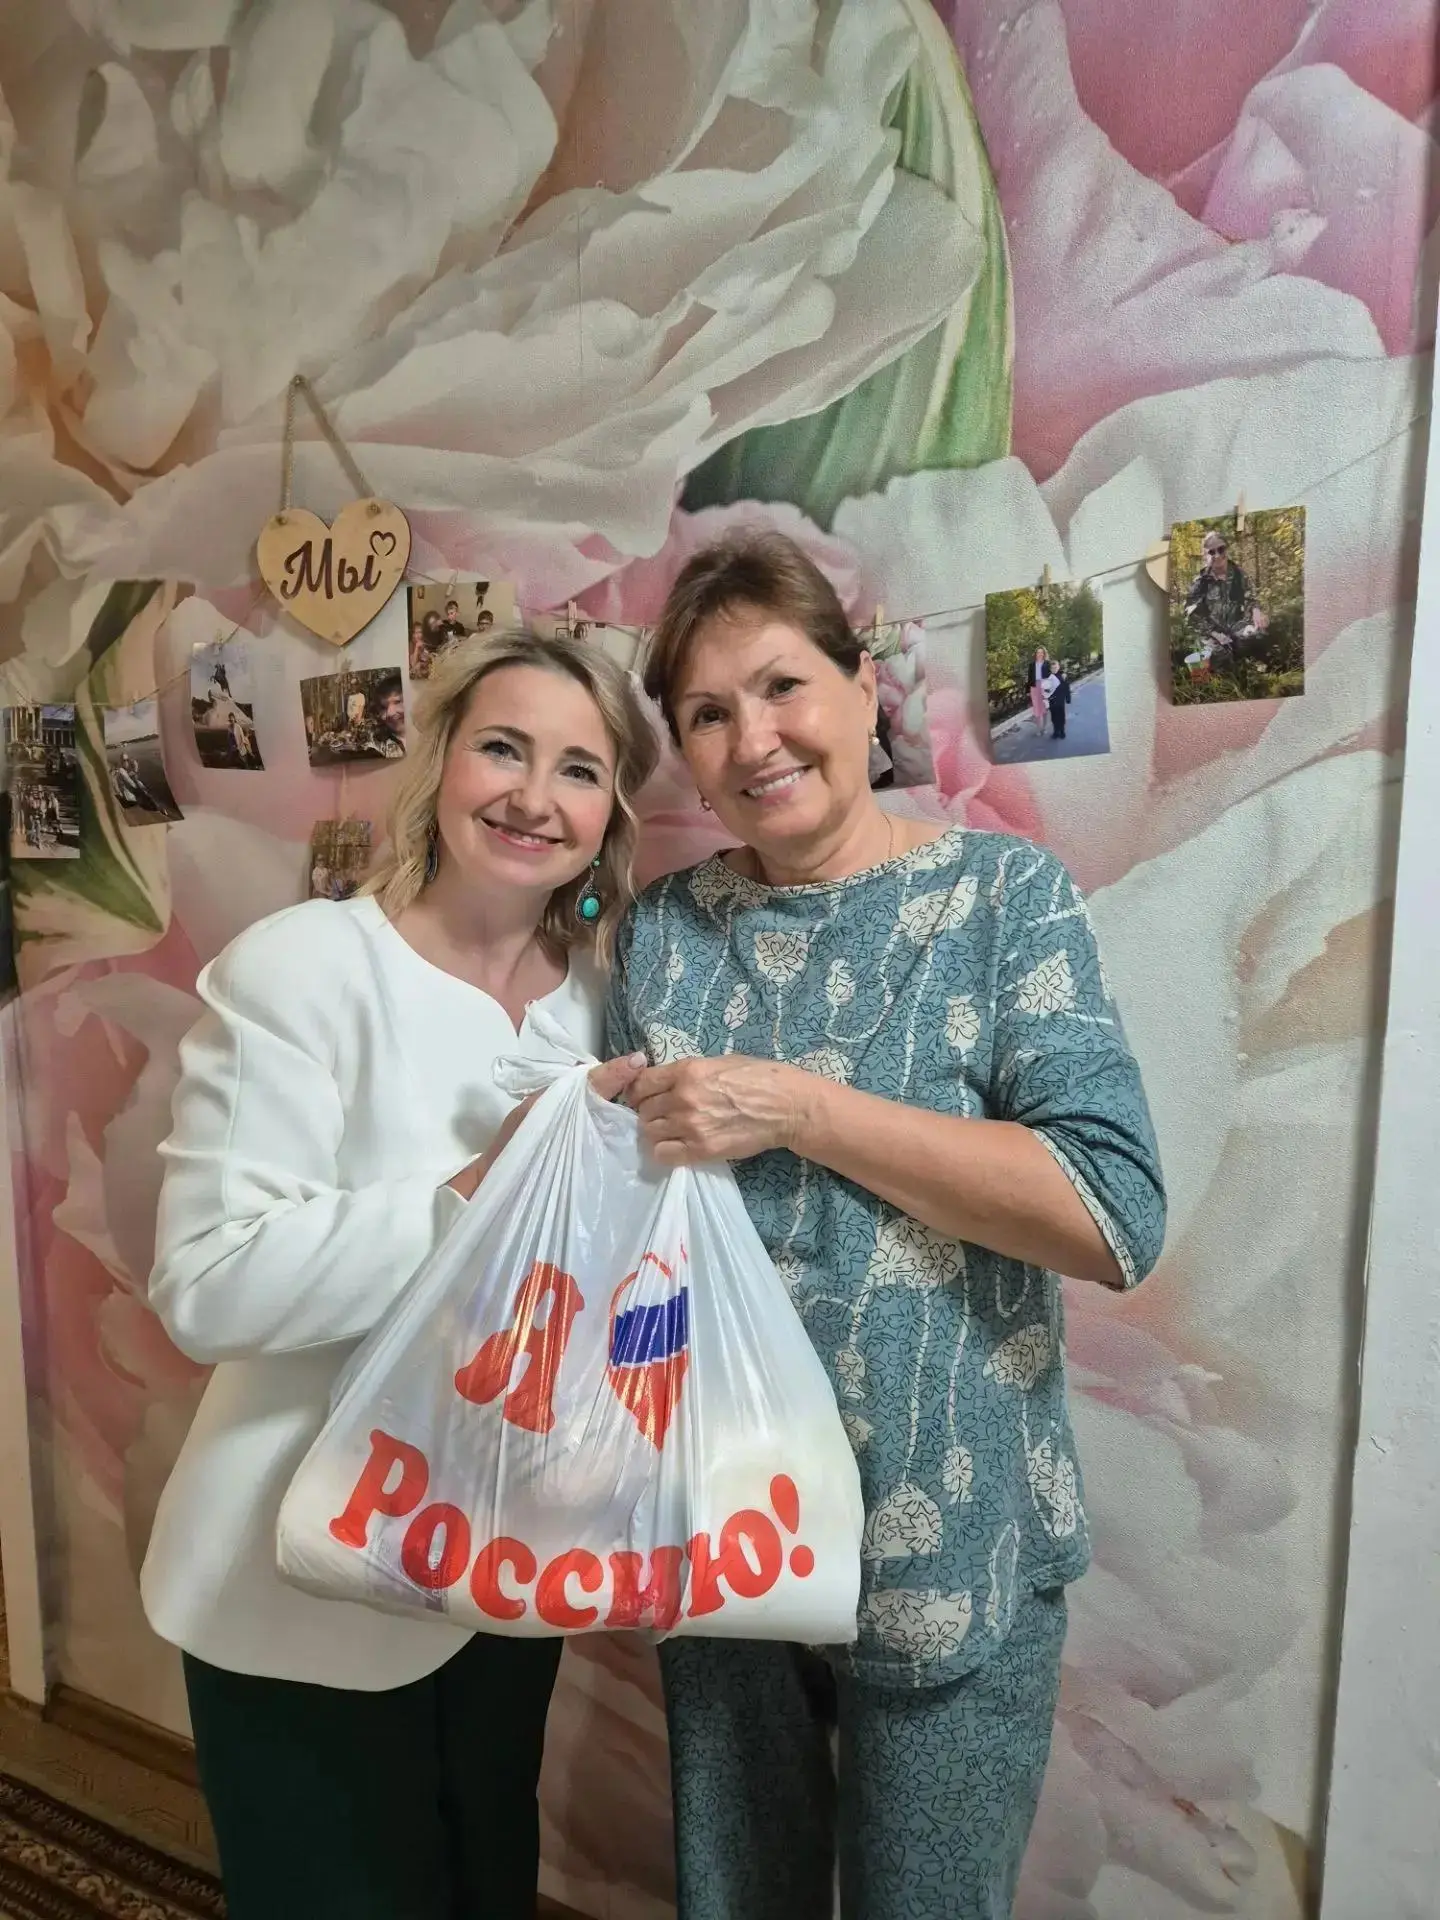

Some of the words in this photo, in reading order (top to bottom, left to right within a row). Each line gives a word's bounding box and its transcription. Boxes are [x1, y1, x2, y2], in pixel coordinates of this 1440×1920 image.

[280, 538, 381, 600] Мы
[455, 1261, 584, 1433] Я
[329, 1429, 814, 1630] Россию!
